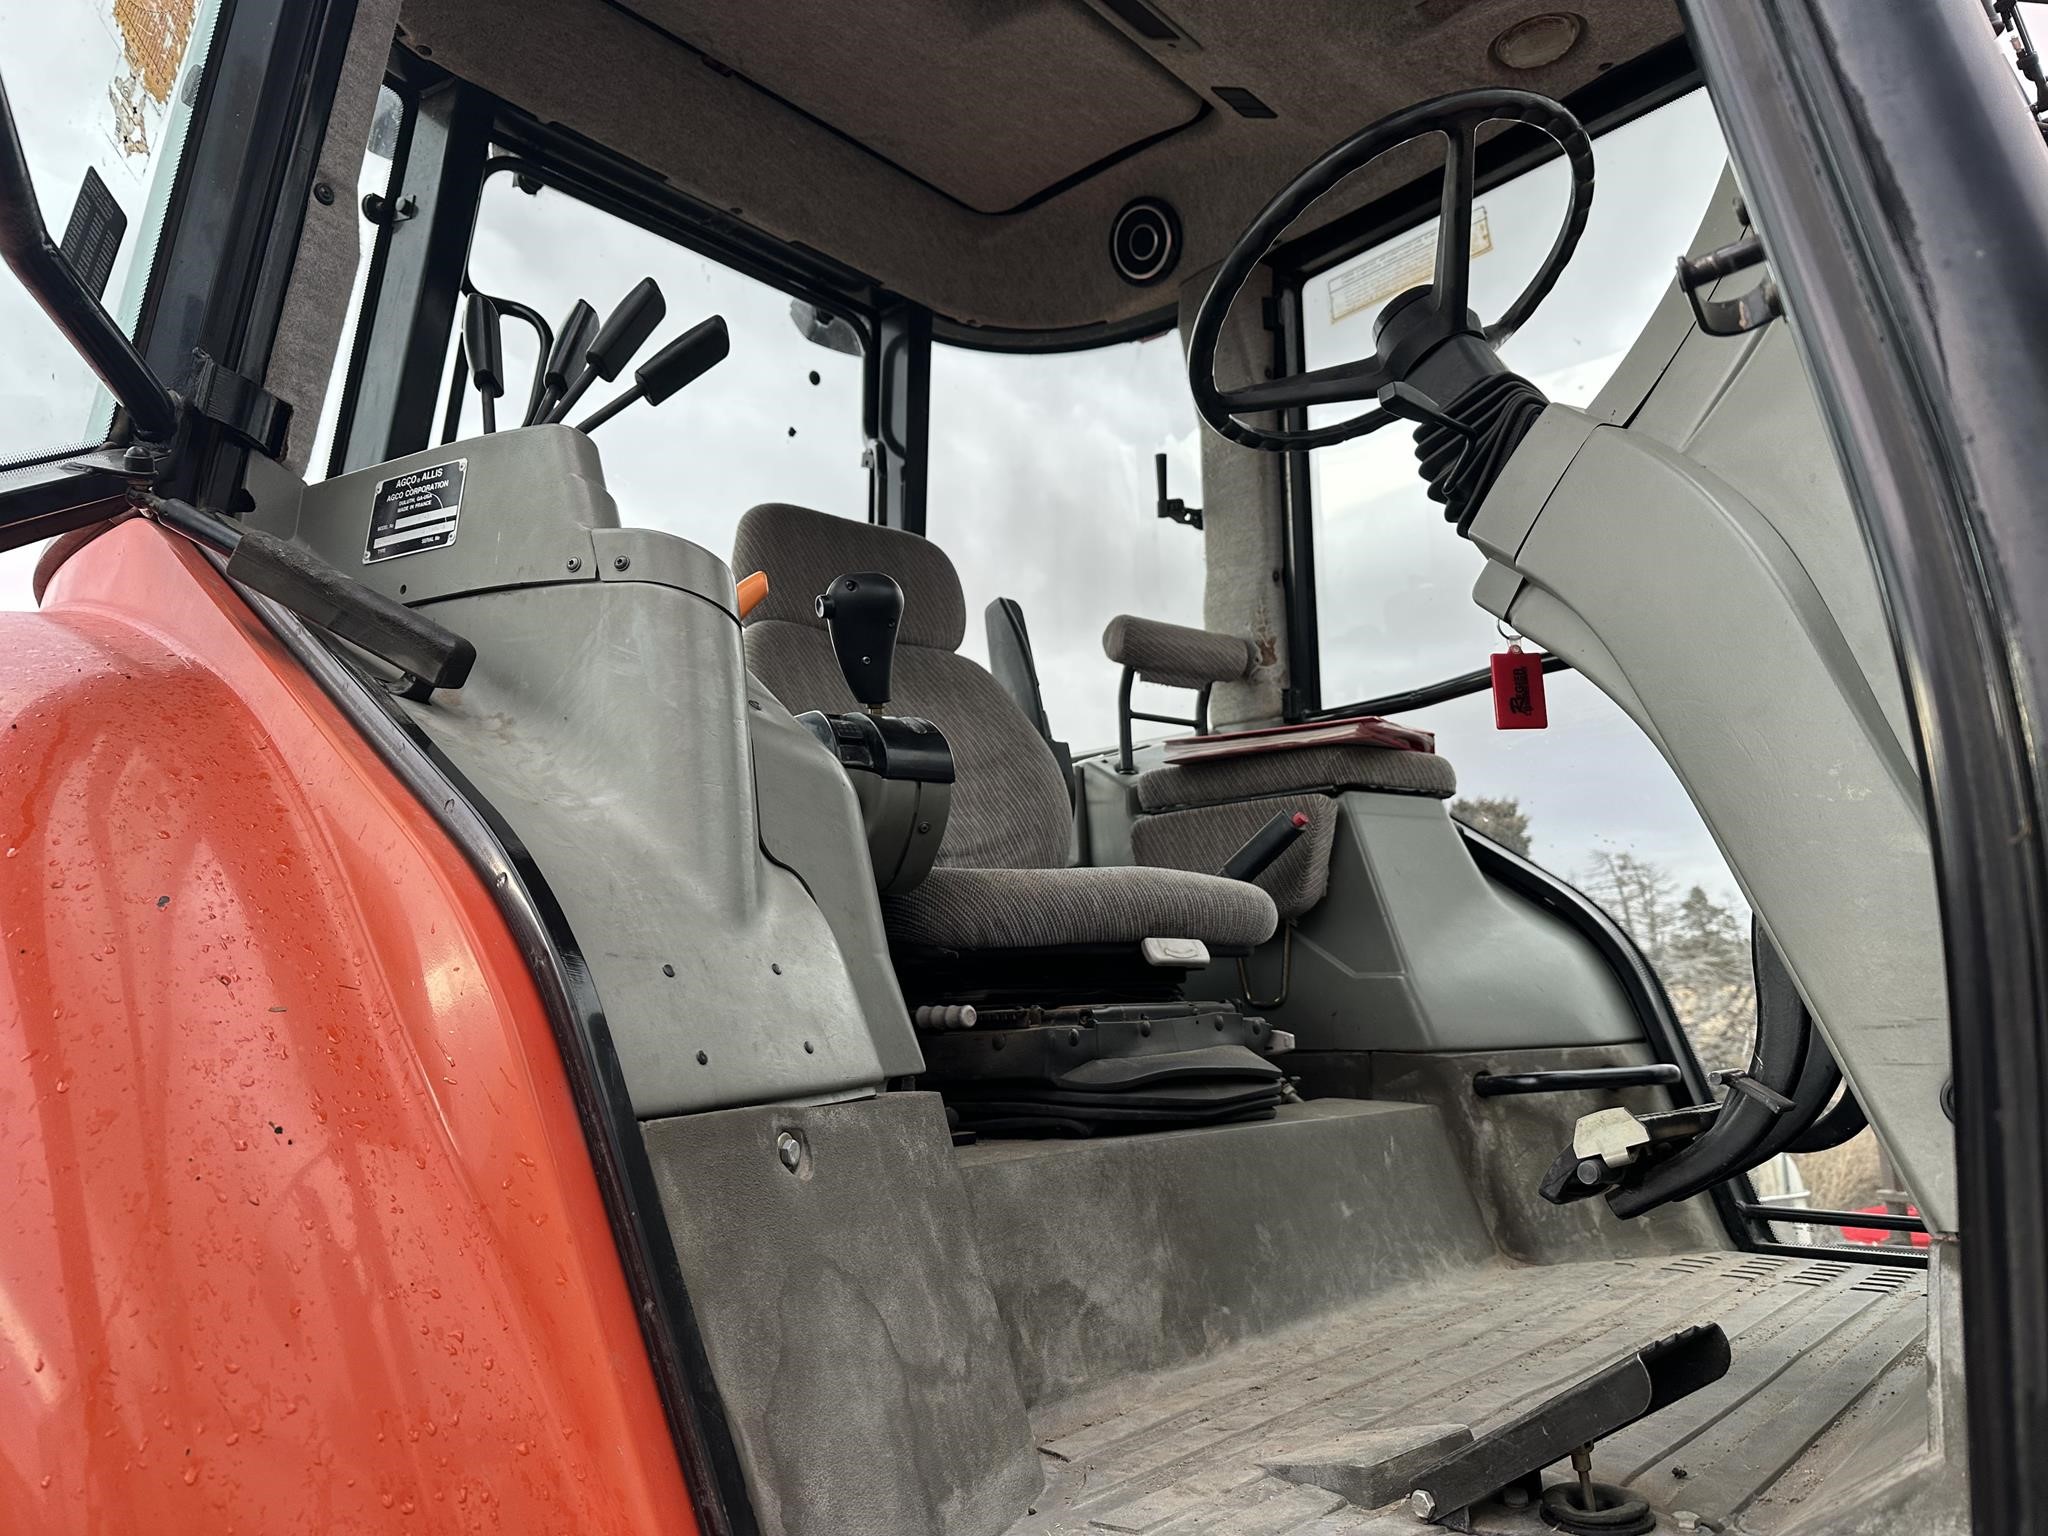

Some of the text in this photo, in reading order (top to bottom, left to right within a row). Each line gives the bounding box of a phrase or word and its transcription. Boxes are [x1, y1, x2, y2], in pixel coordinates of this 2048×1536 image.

[421, 468, 443, 481] ALLIS
[386, 480, 449, 502] AGCO CORPORATION
